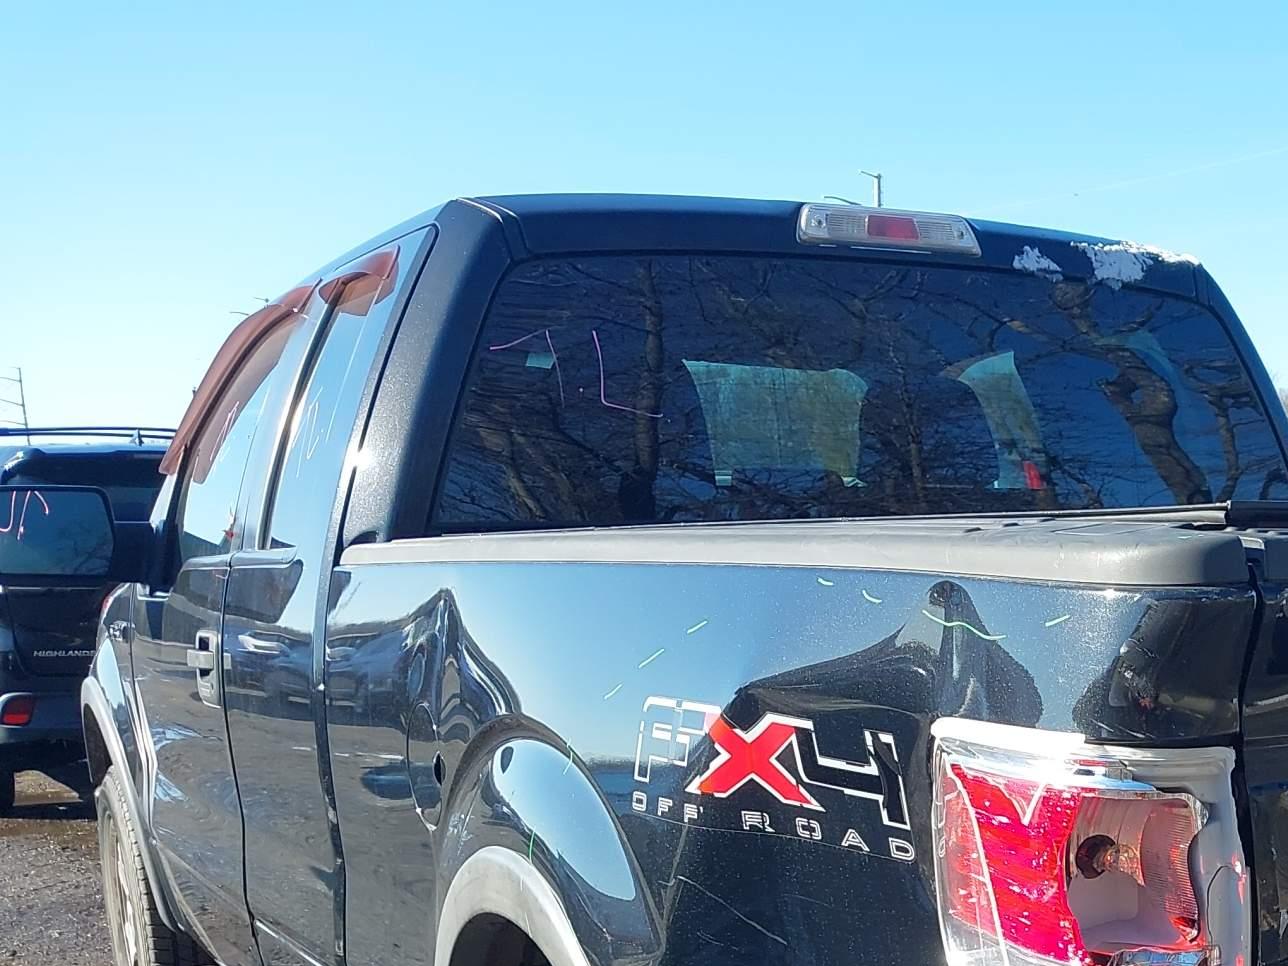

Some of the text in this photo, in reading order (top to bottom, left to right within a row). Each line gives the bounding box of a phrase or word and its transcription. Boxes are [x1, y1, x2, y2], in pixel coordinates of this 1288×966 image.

[33, 649, 96, 657] HIGHLANDE
[633, 696, 911, 830] FX4
[632, 791, 915, 861] OFF ROAD
